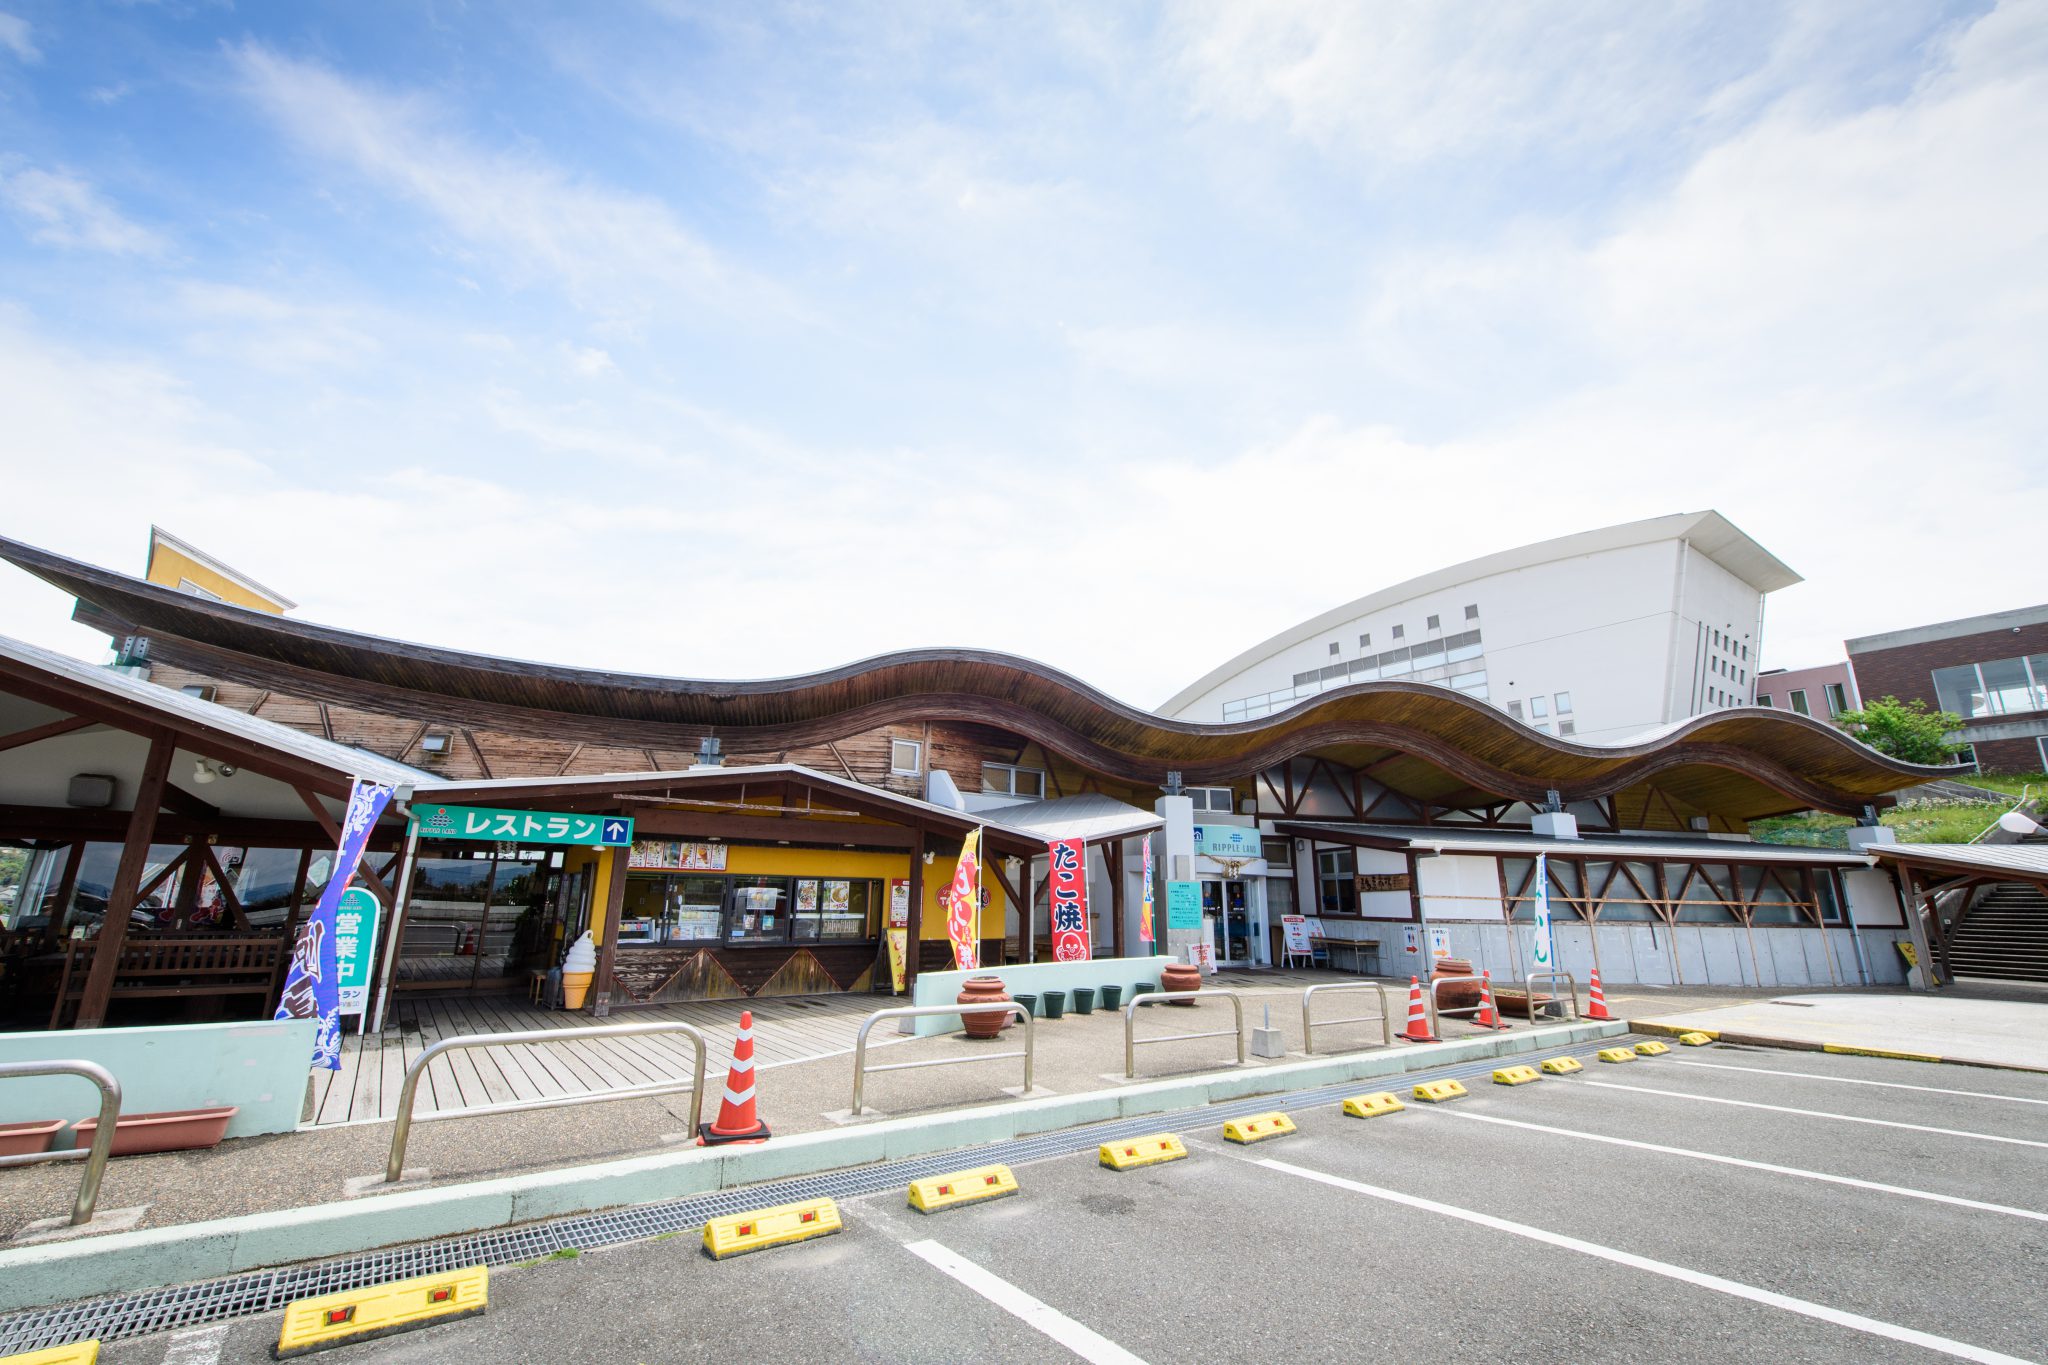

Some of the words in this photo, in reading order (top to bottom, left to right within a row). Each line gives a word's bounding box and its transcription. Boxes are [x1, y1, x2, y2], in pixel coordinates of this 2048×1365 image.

[465, 812, 596, 839] レストラン
[1212, 842, 1240, 853] RIPPLE
[1242, 843, 1257, 853] LAND
[1053, 842, 1083, 932] たこ焼
